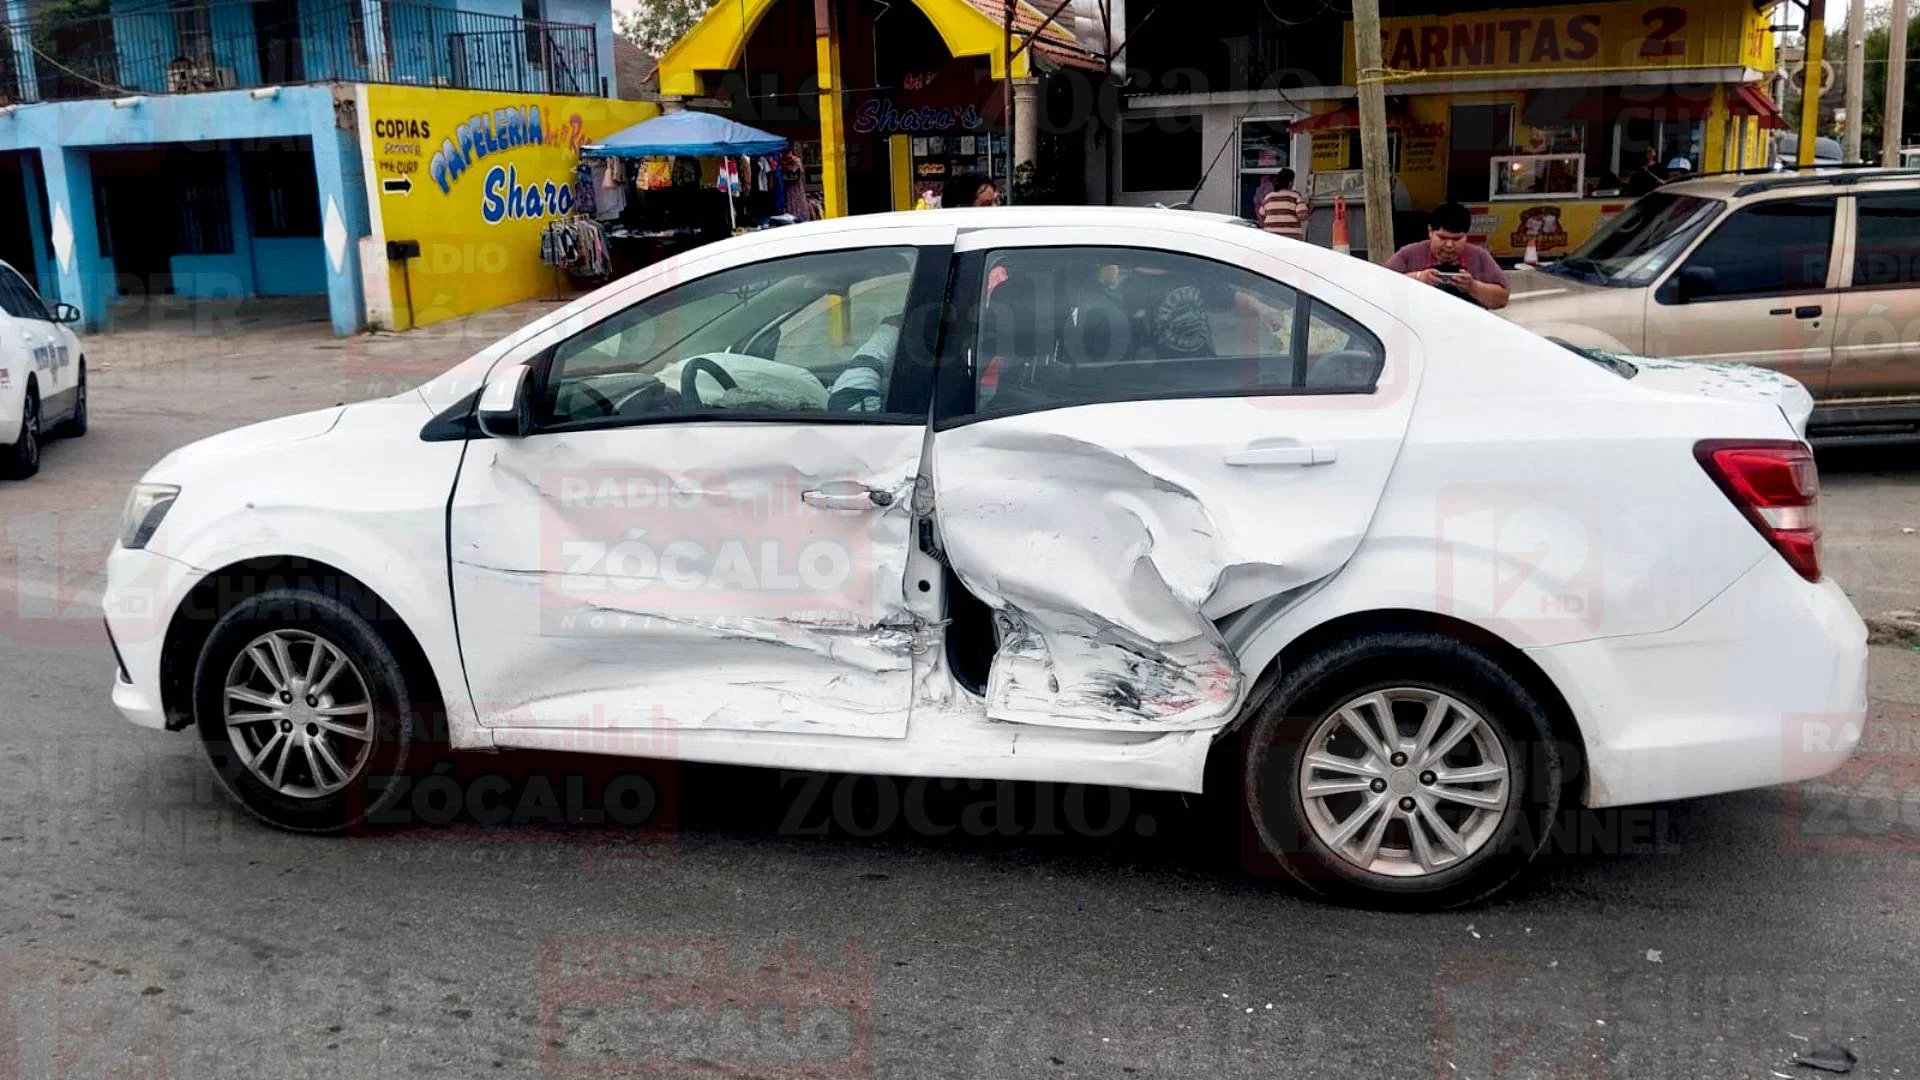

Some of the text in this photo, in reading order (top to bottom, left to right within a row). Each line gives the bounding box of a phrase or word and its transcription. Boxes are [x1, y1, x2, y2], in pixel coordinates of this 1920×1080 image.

[1639, 6, 1687, 58] 2
[375, 119, 430, 139] COPIAS
[854, 98, 983, 133] Sharo's
[430, 104, 544, 196] PAPELERIA
[482, 162, 575, 226] Sharo
